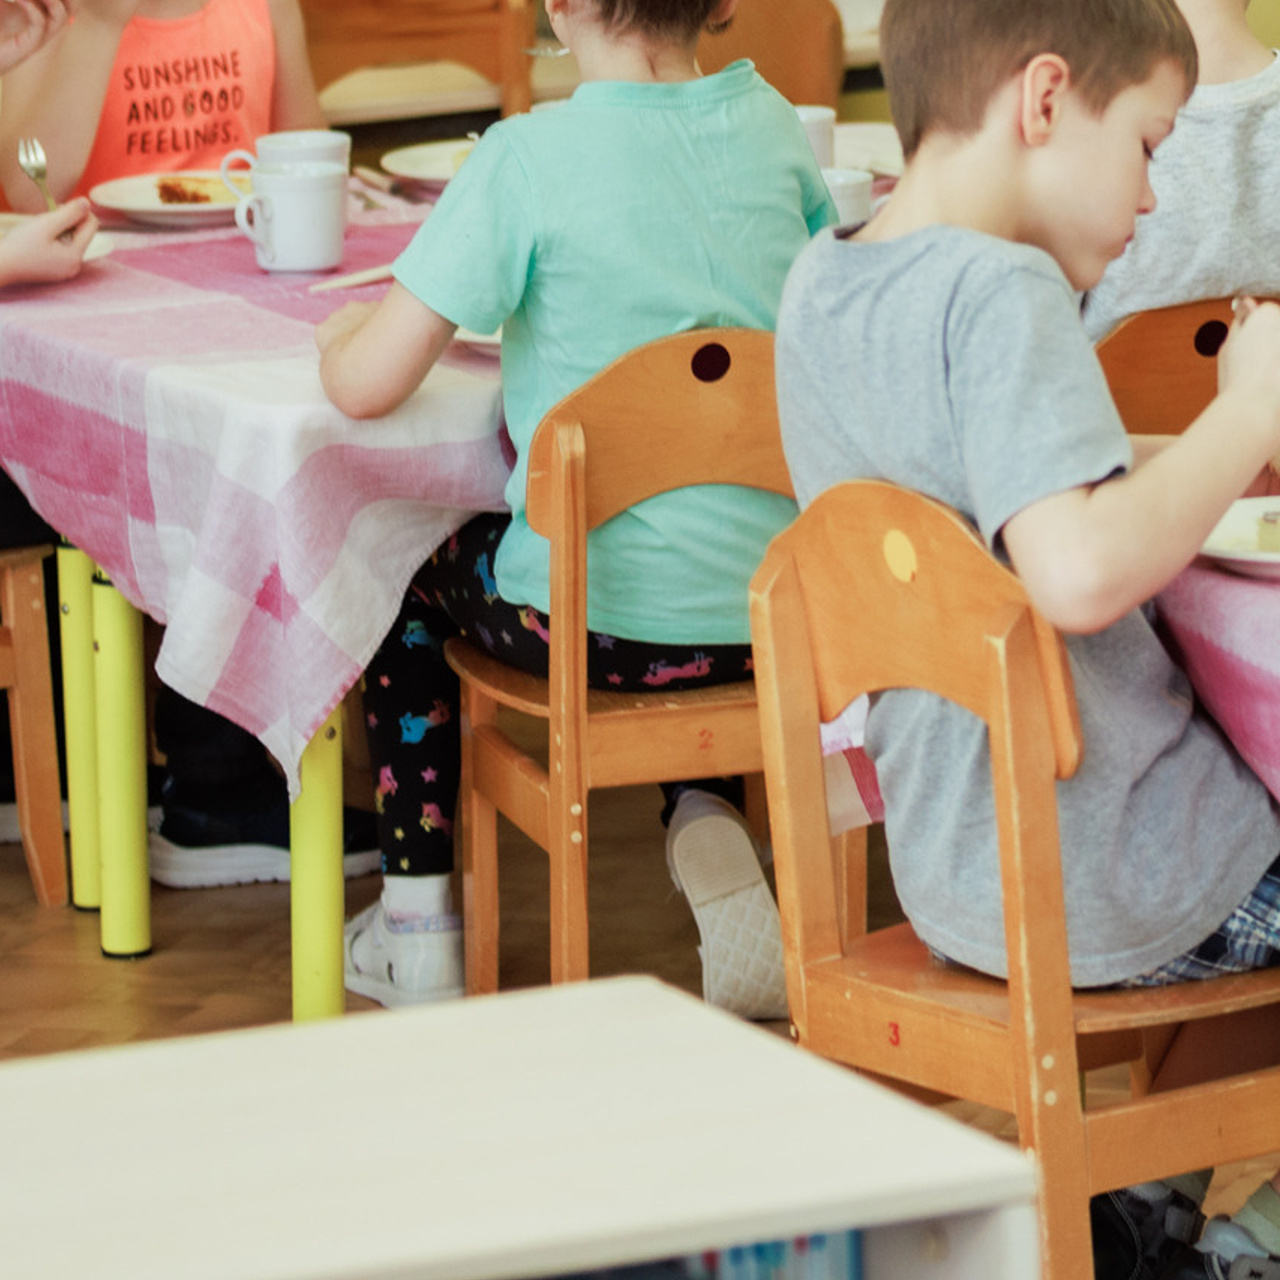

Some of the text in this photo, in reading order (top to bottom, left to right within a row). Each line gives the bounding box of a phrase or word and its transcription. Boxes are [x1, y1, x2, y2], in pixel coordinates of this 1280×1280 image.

[124, 50, 240, 91] SUNSHINE
[127, 85, 244, 124] AND GOOD
[127, 121, 239, 155] FEELINGS.
[699, 729, 713, 749] 2
[888, 1022, 900, 1046] 3
